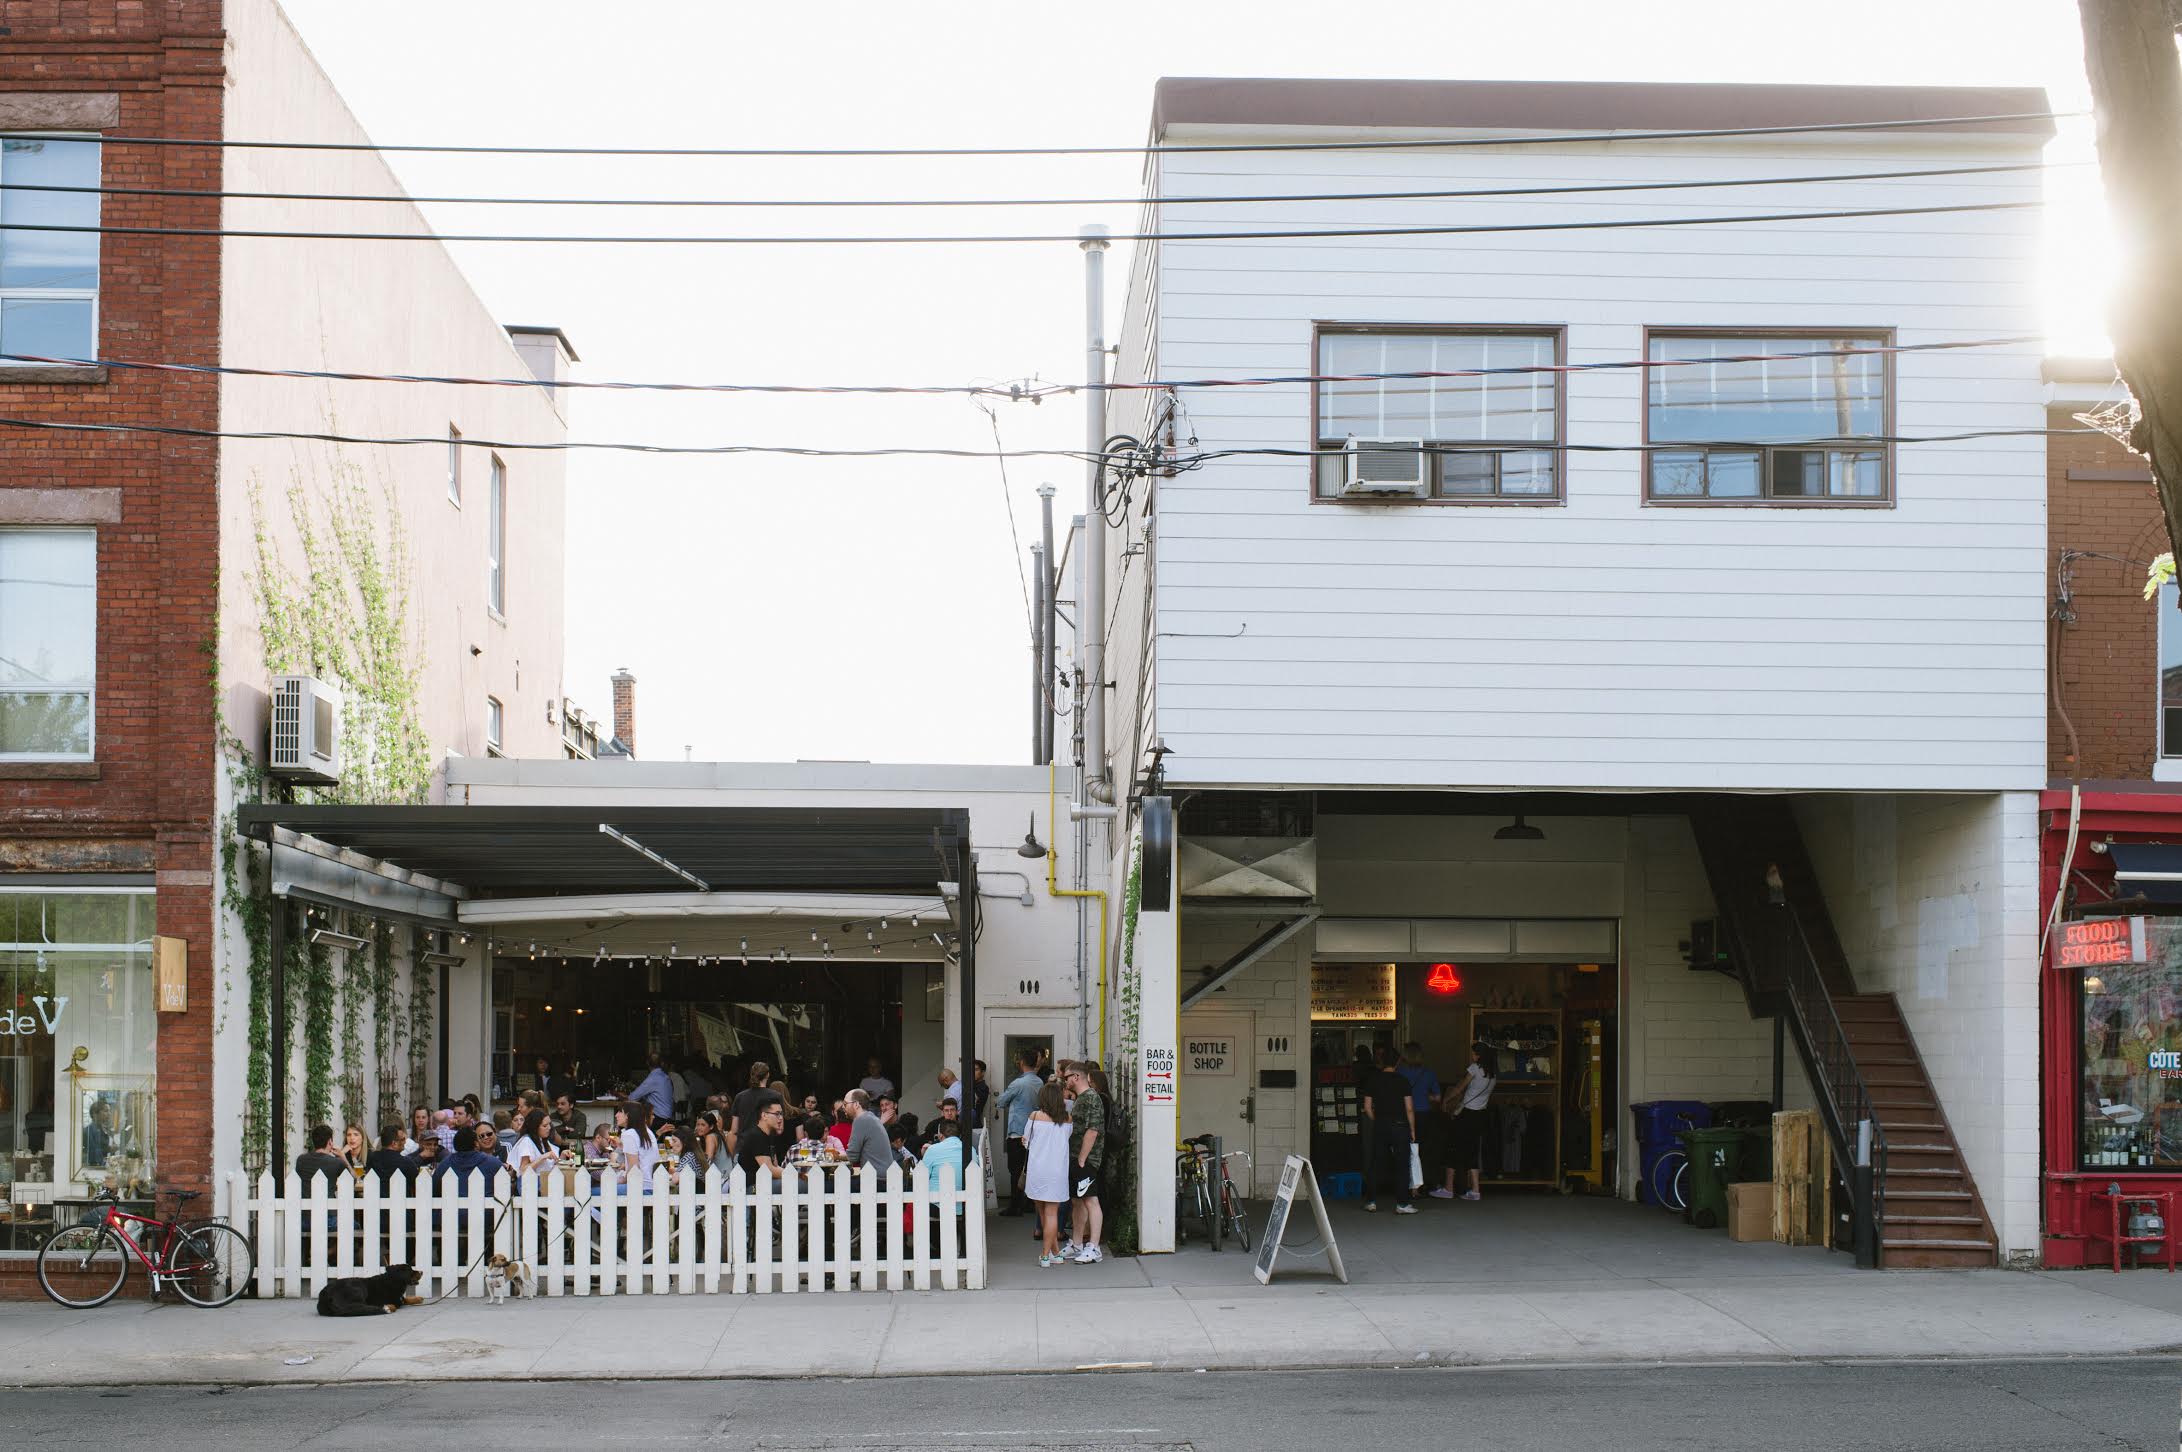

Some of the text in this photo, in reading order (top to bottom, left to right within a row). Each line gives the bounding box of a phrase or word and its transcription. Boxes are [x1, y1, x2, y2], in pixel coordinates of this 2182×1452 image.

[2066, 922, 2119, 944] FOOD
[2061, 943, 2122, 965] STORE
[163, 983, 185, 1007] VdeV
[1146, 1048, 1174, 1060] BAR &
[1189, 1042, 1227, 1054] BOTTLE
[1194, 1057, 1224, 1070] SHOP
[2148, 1047, 2182, 1068] CÔTE
[1147, 1060, 1173, 1071] FOOD
[1145, 1083, 1174, 1094] RETAIL
